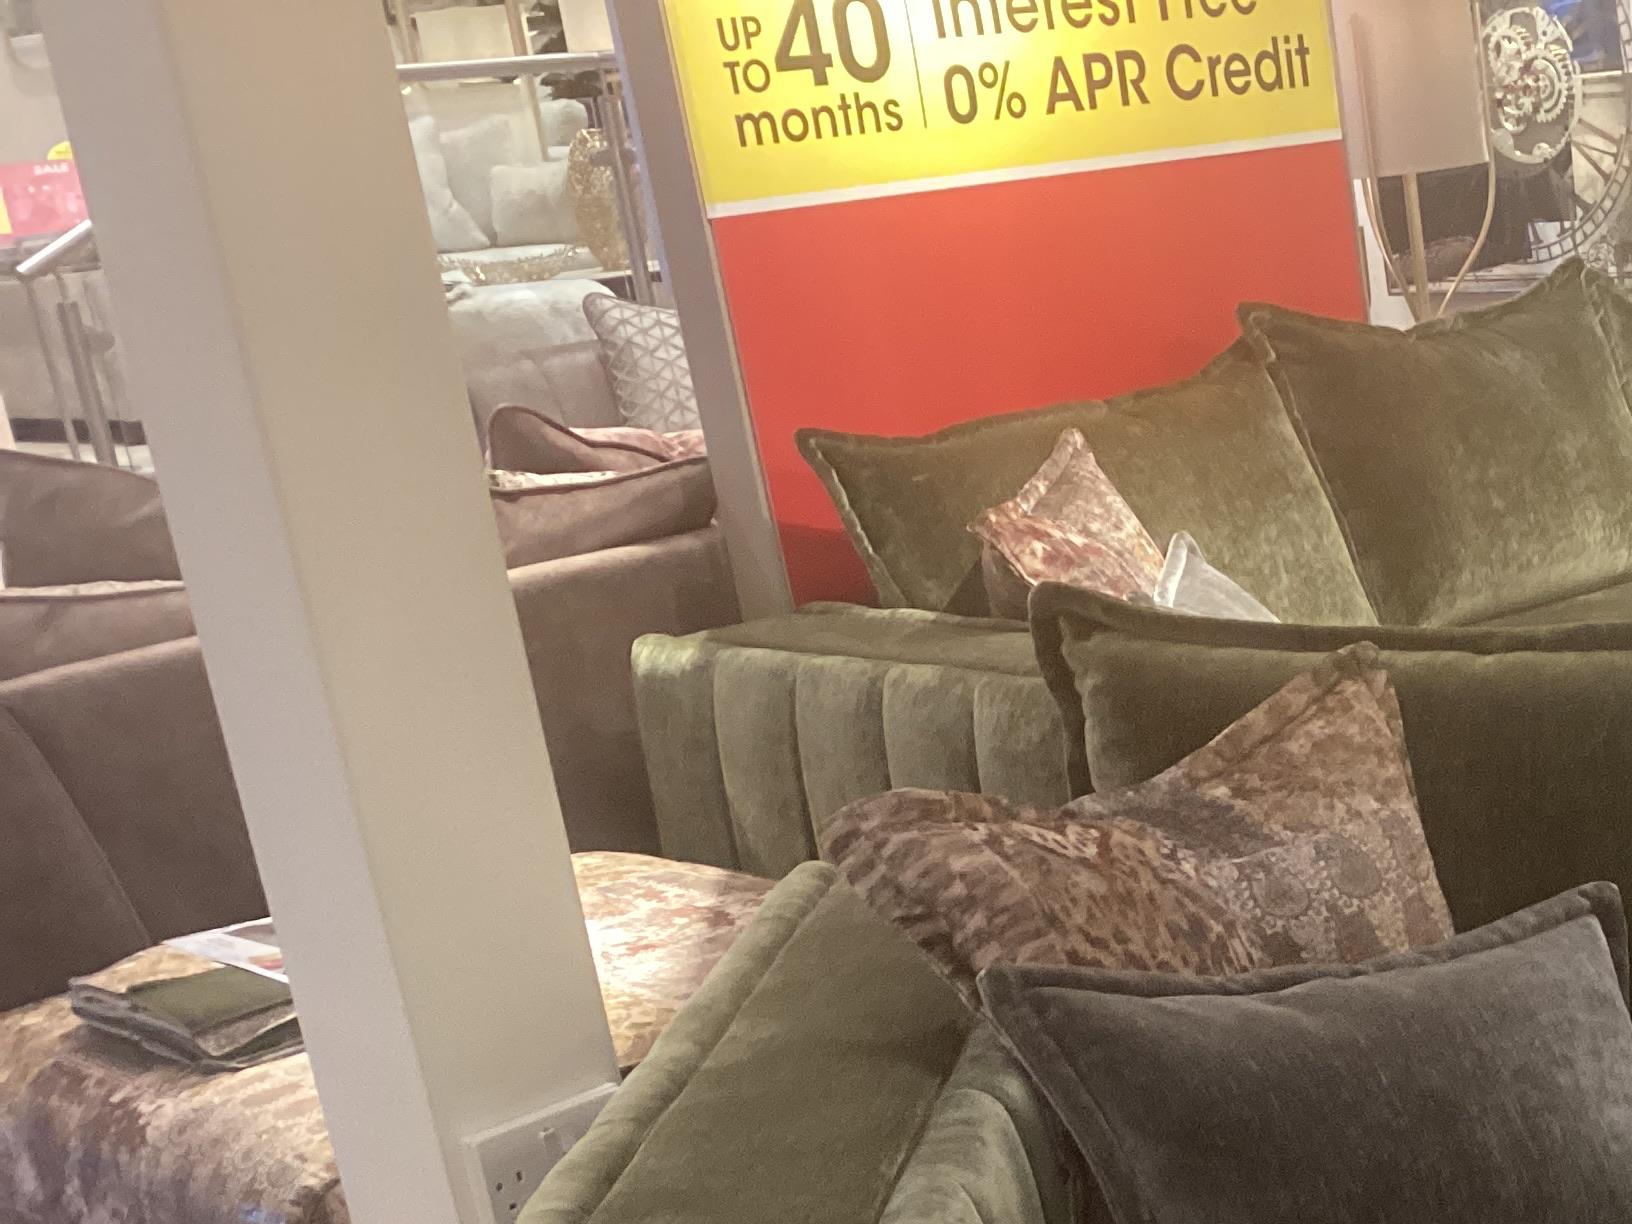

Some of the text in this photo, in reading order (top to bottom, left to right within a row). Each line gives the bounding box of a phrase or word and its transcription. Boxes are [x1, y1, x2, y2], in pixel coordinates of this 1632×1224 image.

[716, 0, 892, 87] UP 40
[722, 58, 771, 95] TO
[943, 33, 1311, 125] 0% APR Credit
[734, 91, 904, 148] months
